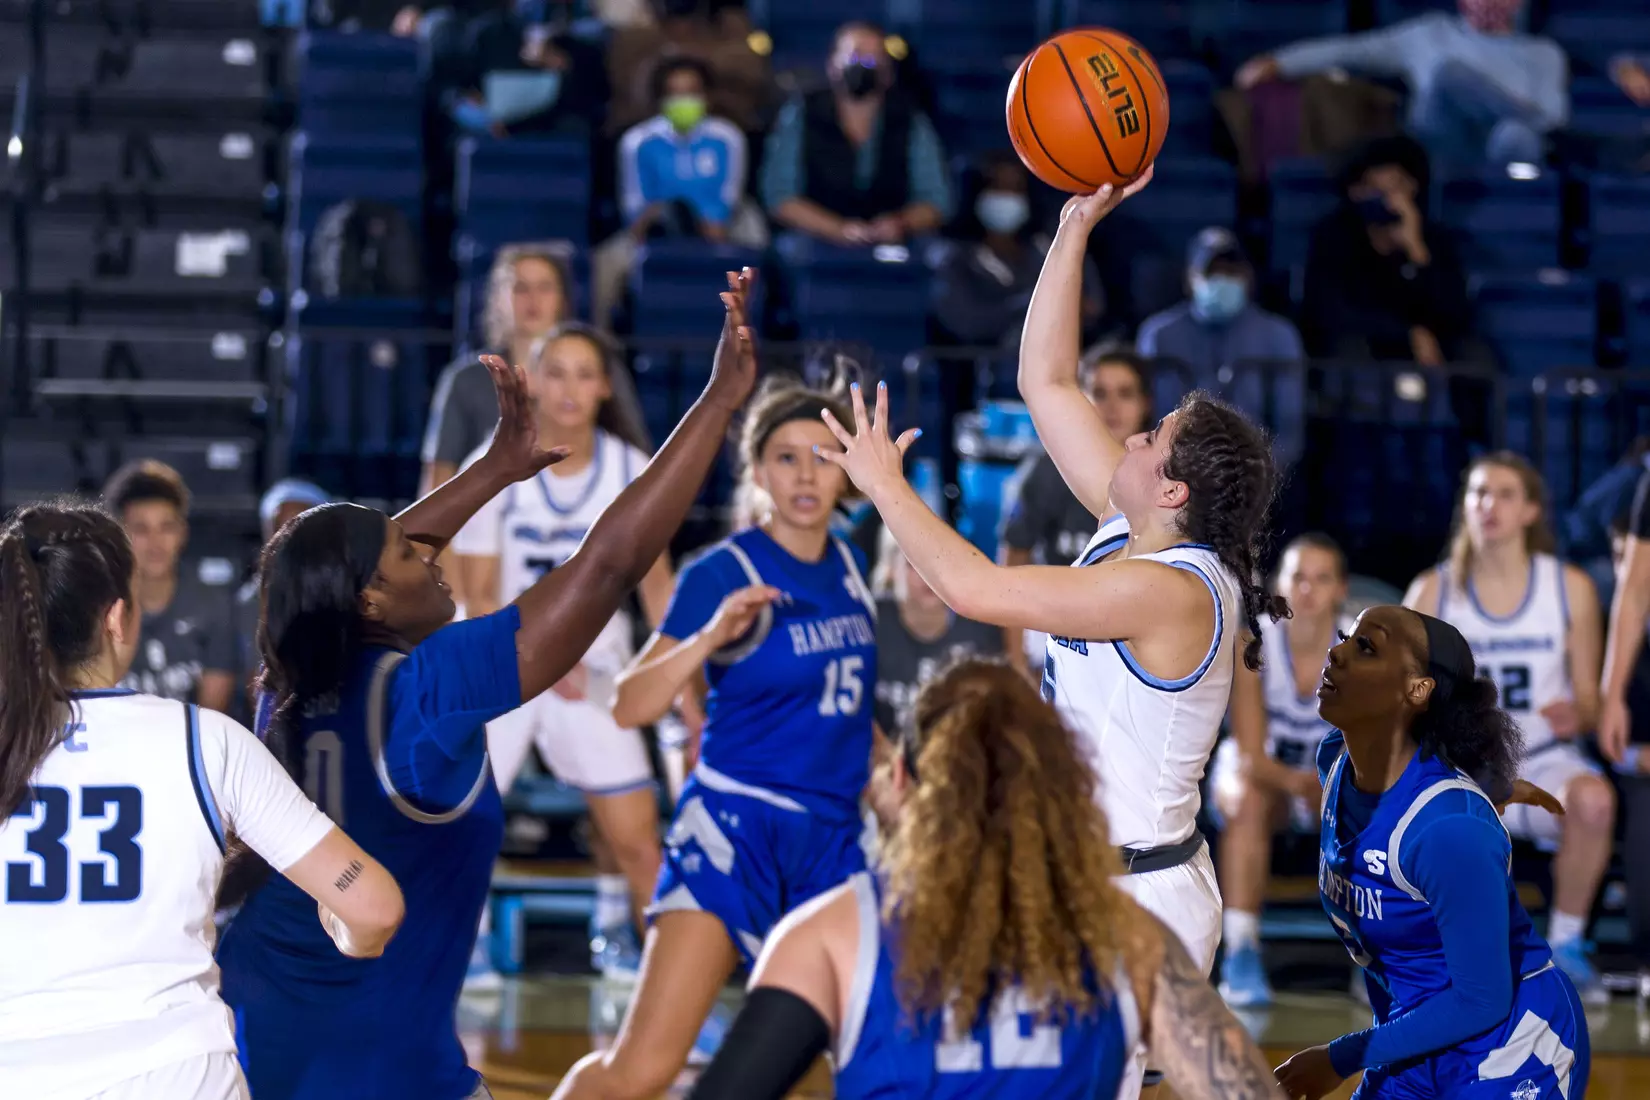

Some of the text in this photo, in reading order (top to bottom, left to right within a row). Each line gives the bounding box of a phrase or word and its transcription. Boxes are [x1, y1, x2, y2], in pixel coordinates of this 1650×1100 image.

[1086, 52, 1141, 139] ELITE
[818, 655, 864, 716] 15
[5, 783, 144, 905] 33
